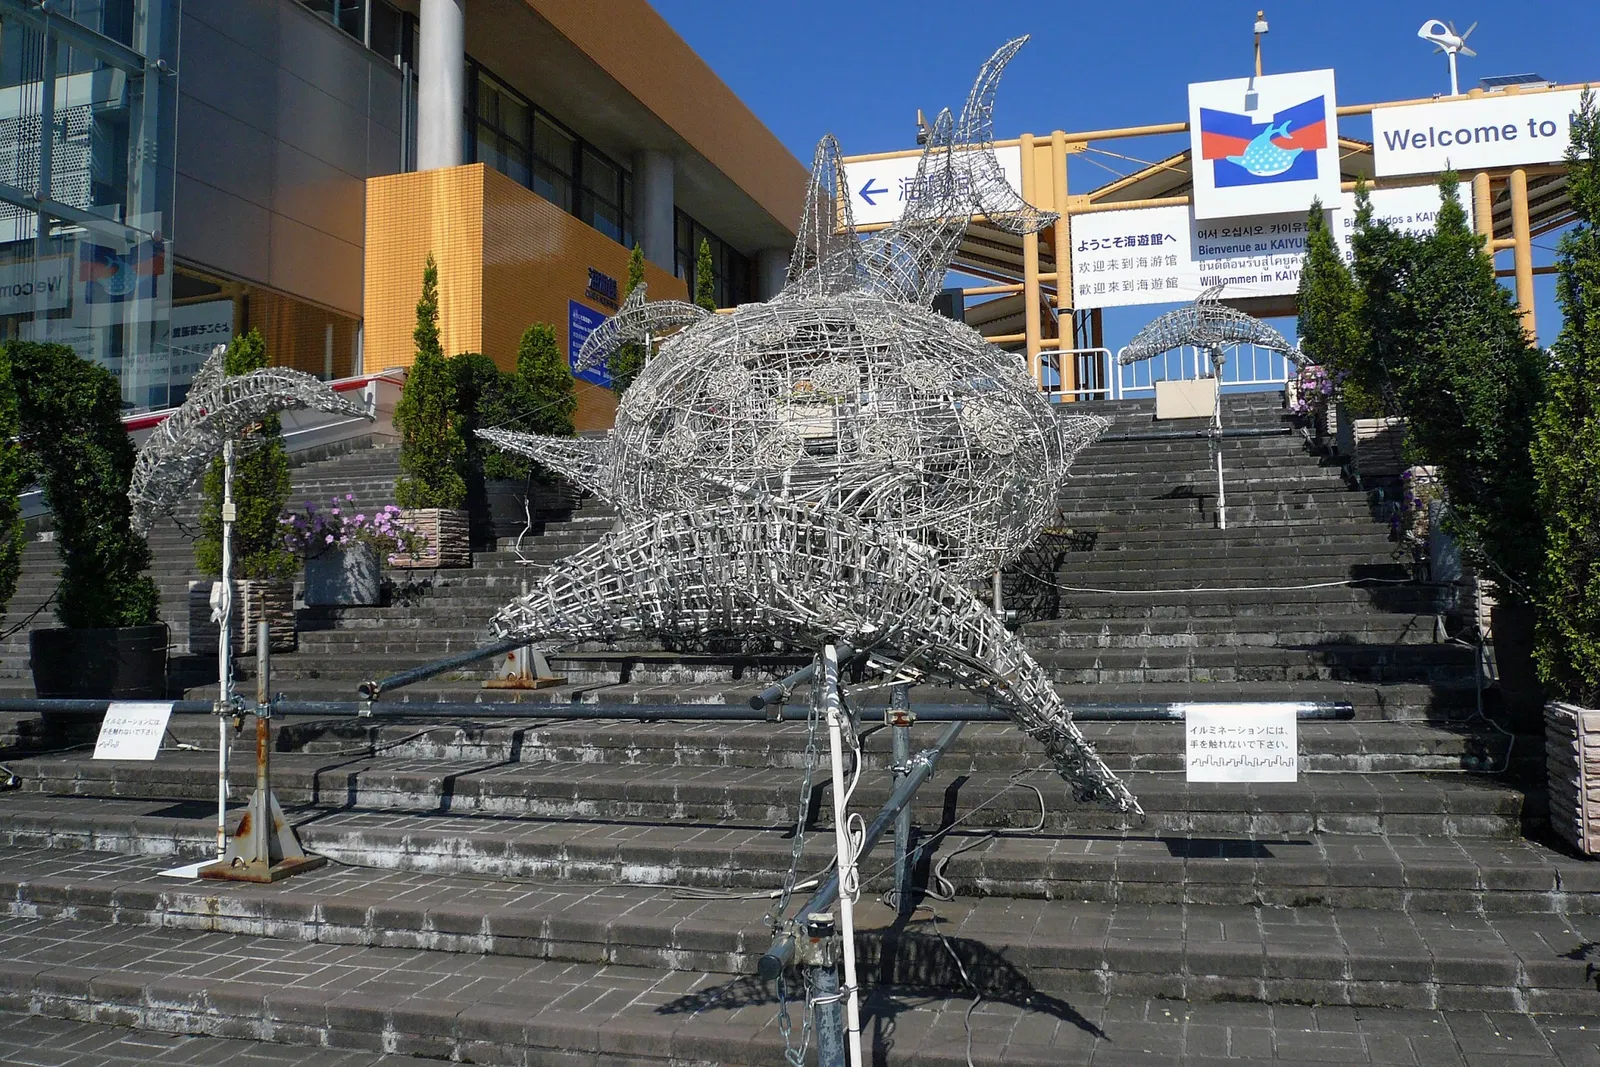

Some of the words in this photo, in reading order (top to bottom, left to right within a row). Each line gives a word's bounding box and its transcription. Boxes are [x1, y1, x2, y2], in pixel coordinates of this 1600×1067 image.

[1383, 123, 1518, 151] Welcome
[1526, 118, 1557, 138] to
[1406, 214, 1413, 223] a
[1197, 228, 1218, 240] 어서
[1077, 233, 1177, 252] ようこそ海遊館へ
[1198, 243, 1252, 256] Bienvenue
[1254, 242, 1267, 252] au
[1078, 254, 1178, 274] 欢迎来到海游馆
[1079, 276, 1179, 296] 歡迎來到海遊館
[1199, 274, 1258, 287] Willkommen
[1260, 272, 1273, 283] im
[1190, 725, 1289, 736] イルミネーションには、
[1190, 739, 1290, 750] 手を触れないで下さい。
